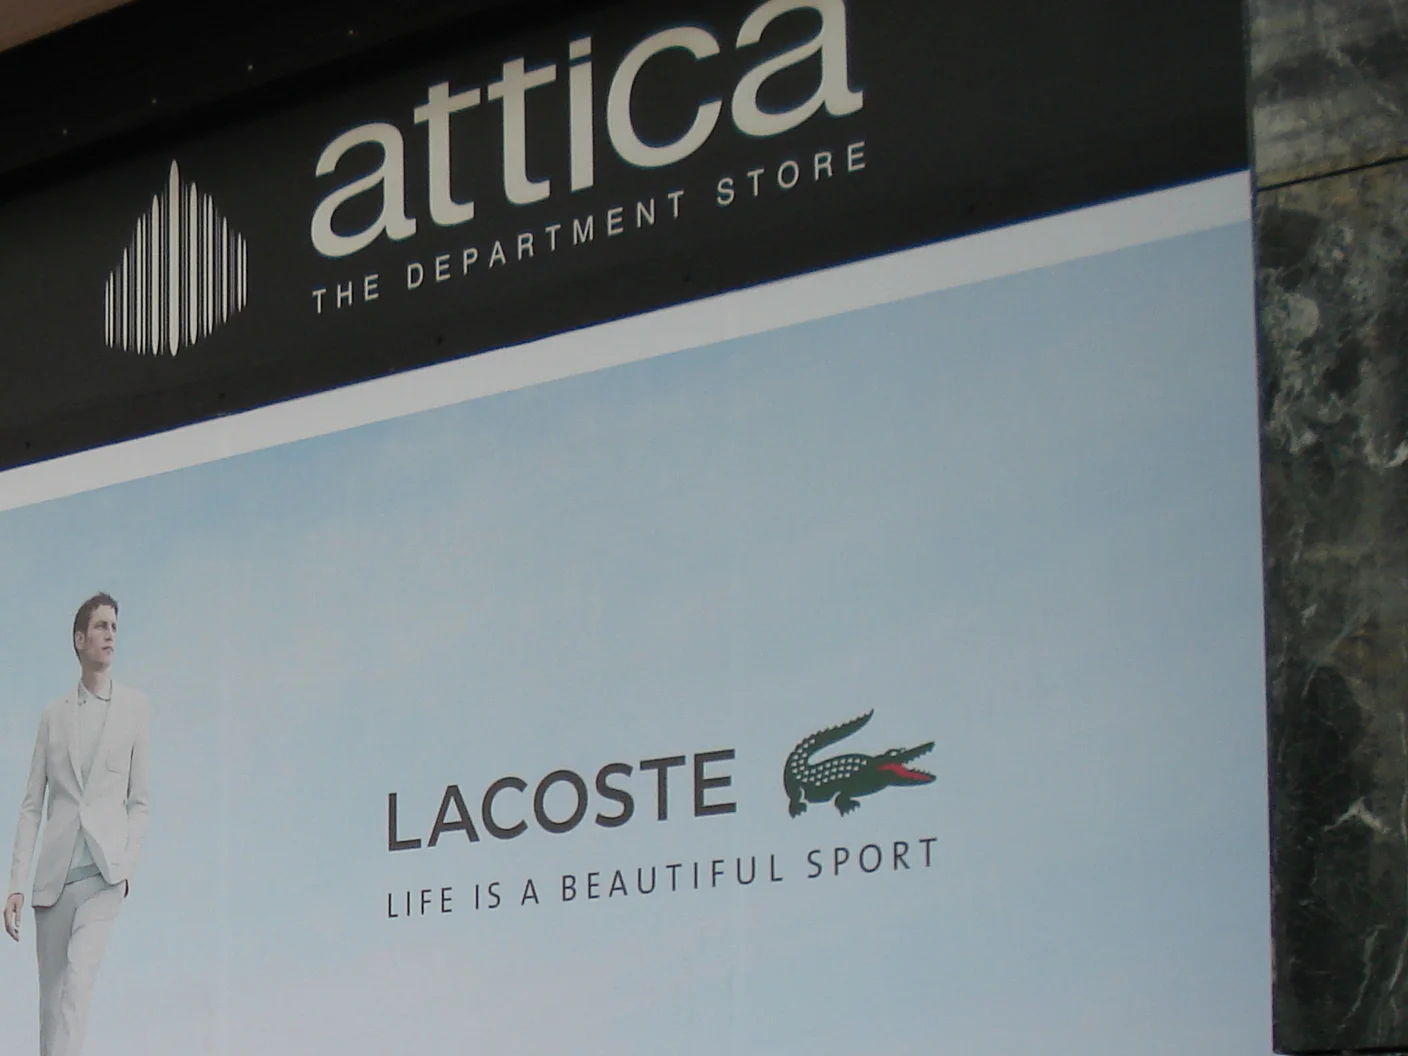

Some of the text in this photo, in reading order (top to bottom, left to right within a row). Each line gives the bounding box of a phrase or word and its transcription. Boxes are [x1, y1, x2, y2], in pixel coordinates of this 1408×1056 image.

[310, 0, 864, 259] attica
[312, 142, 866, 315] THE DEPARTMENT STORE
[388, 749, 737, 851] LACOSTE
[388, 837, 937, 917] LIFE IS A BEAUTIFUL SPORT
